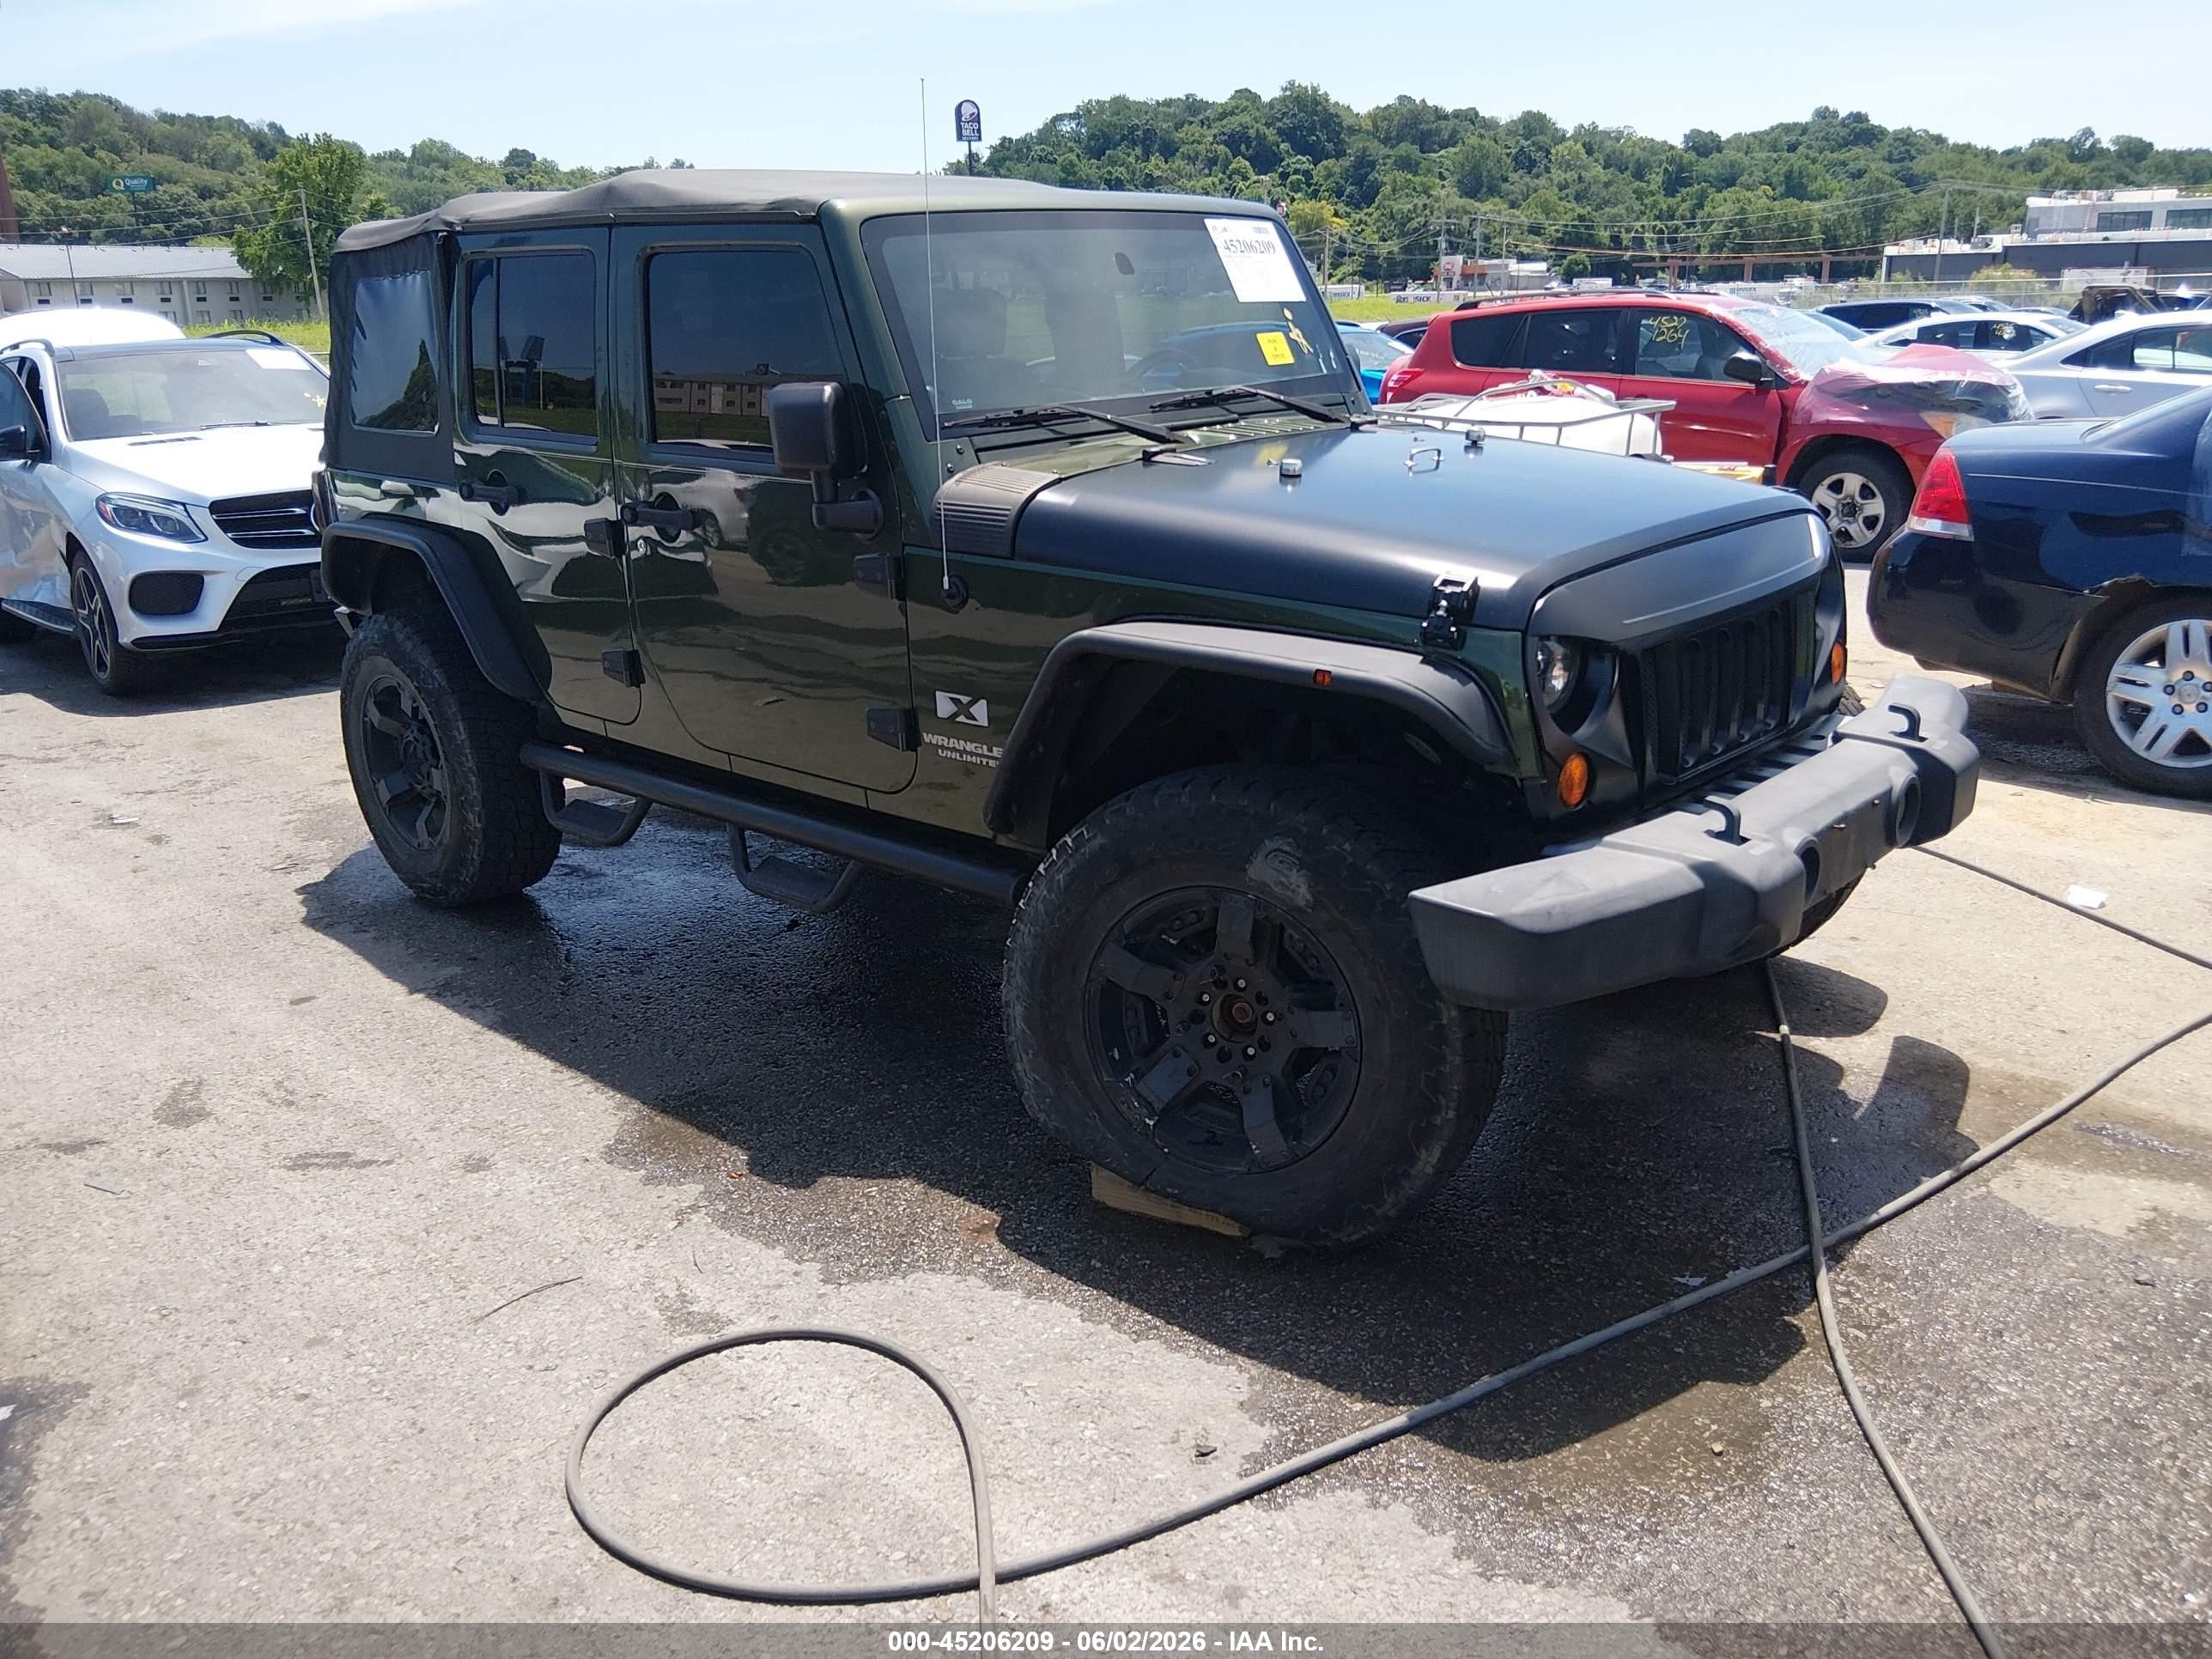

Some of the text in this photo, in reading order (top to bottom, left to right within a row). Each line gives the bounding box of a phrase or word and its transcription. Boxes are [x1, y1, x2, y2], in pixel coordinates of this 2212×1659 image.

[125, 178, 148, 187] Quality
[1223, 239, 1276, 254] 45206209
[1652, 327, 1690, 349] 1264
[922, 732, 1003, 758] WRANGLE
[937, 748, 1000, 769] UNLIMITE
